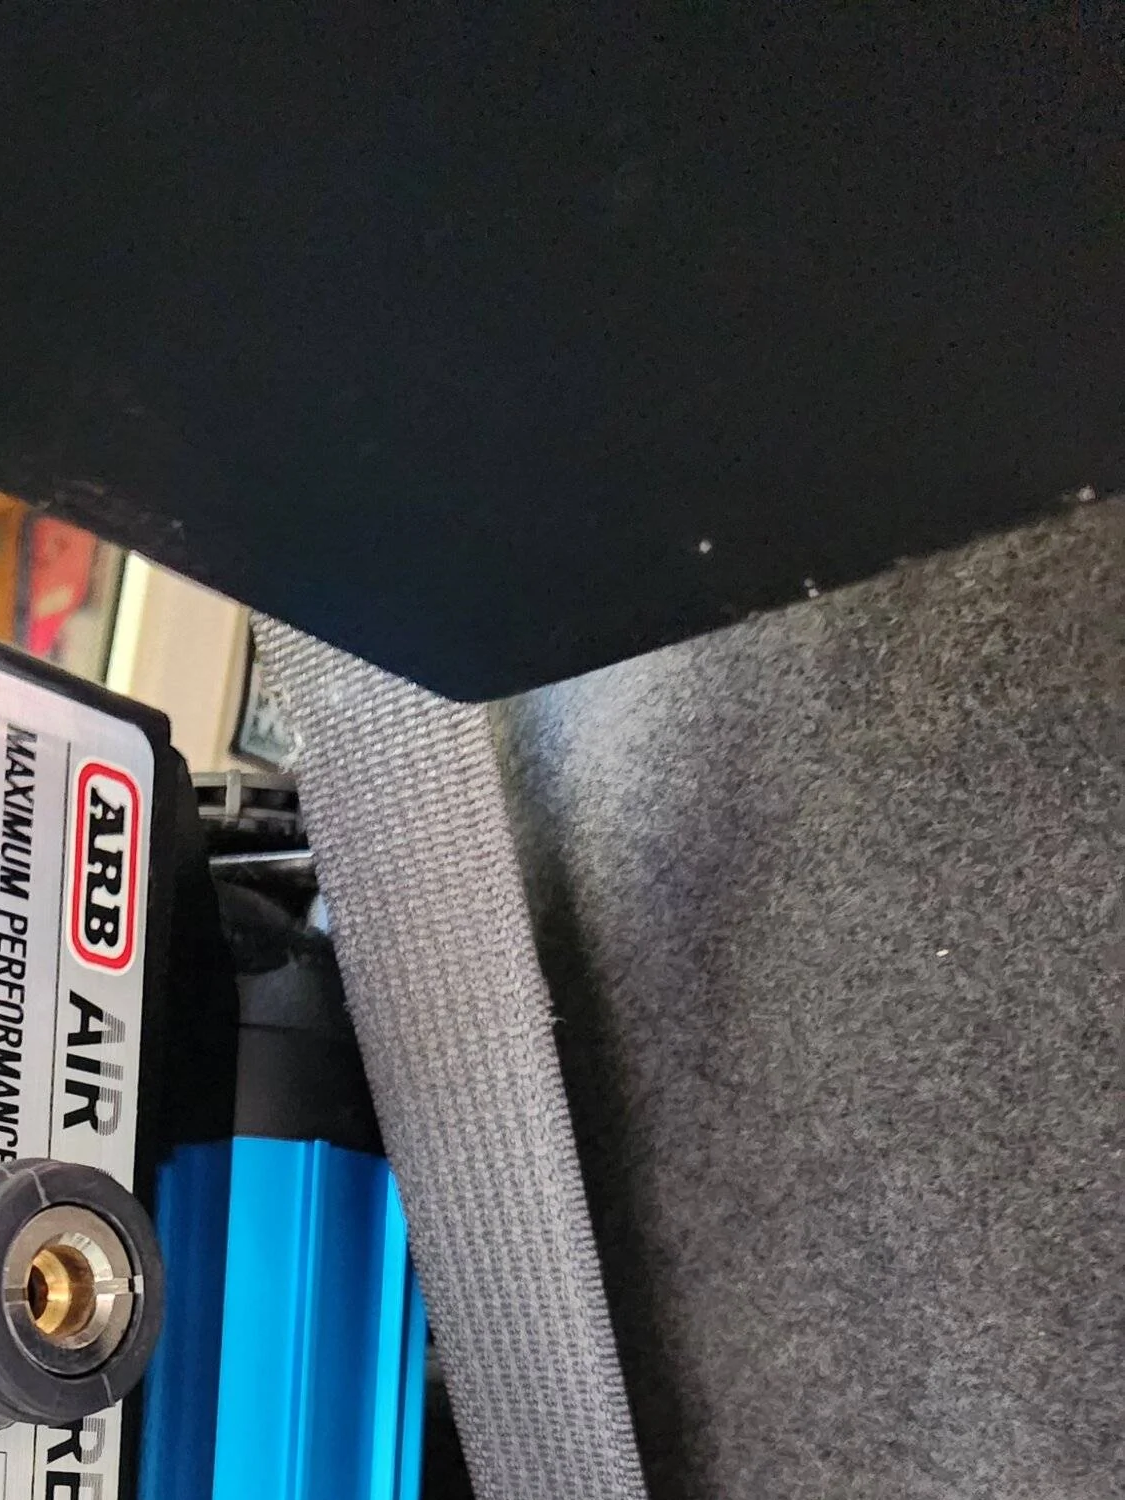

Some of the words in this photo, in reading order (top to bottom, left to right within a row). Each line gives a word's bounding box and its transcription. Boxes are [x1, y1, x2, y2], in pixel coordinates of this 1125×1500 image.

[0, 721, 38, 900] MAXIMUM
[83, 786, 129, 949] ARB
[63, 988, 127, 1137] AIR
